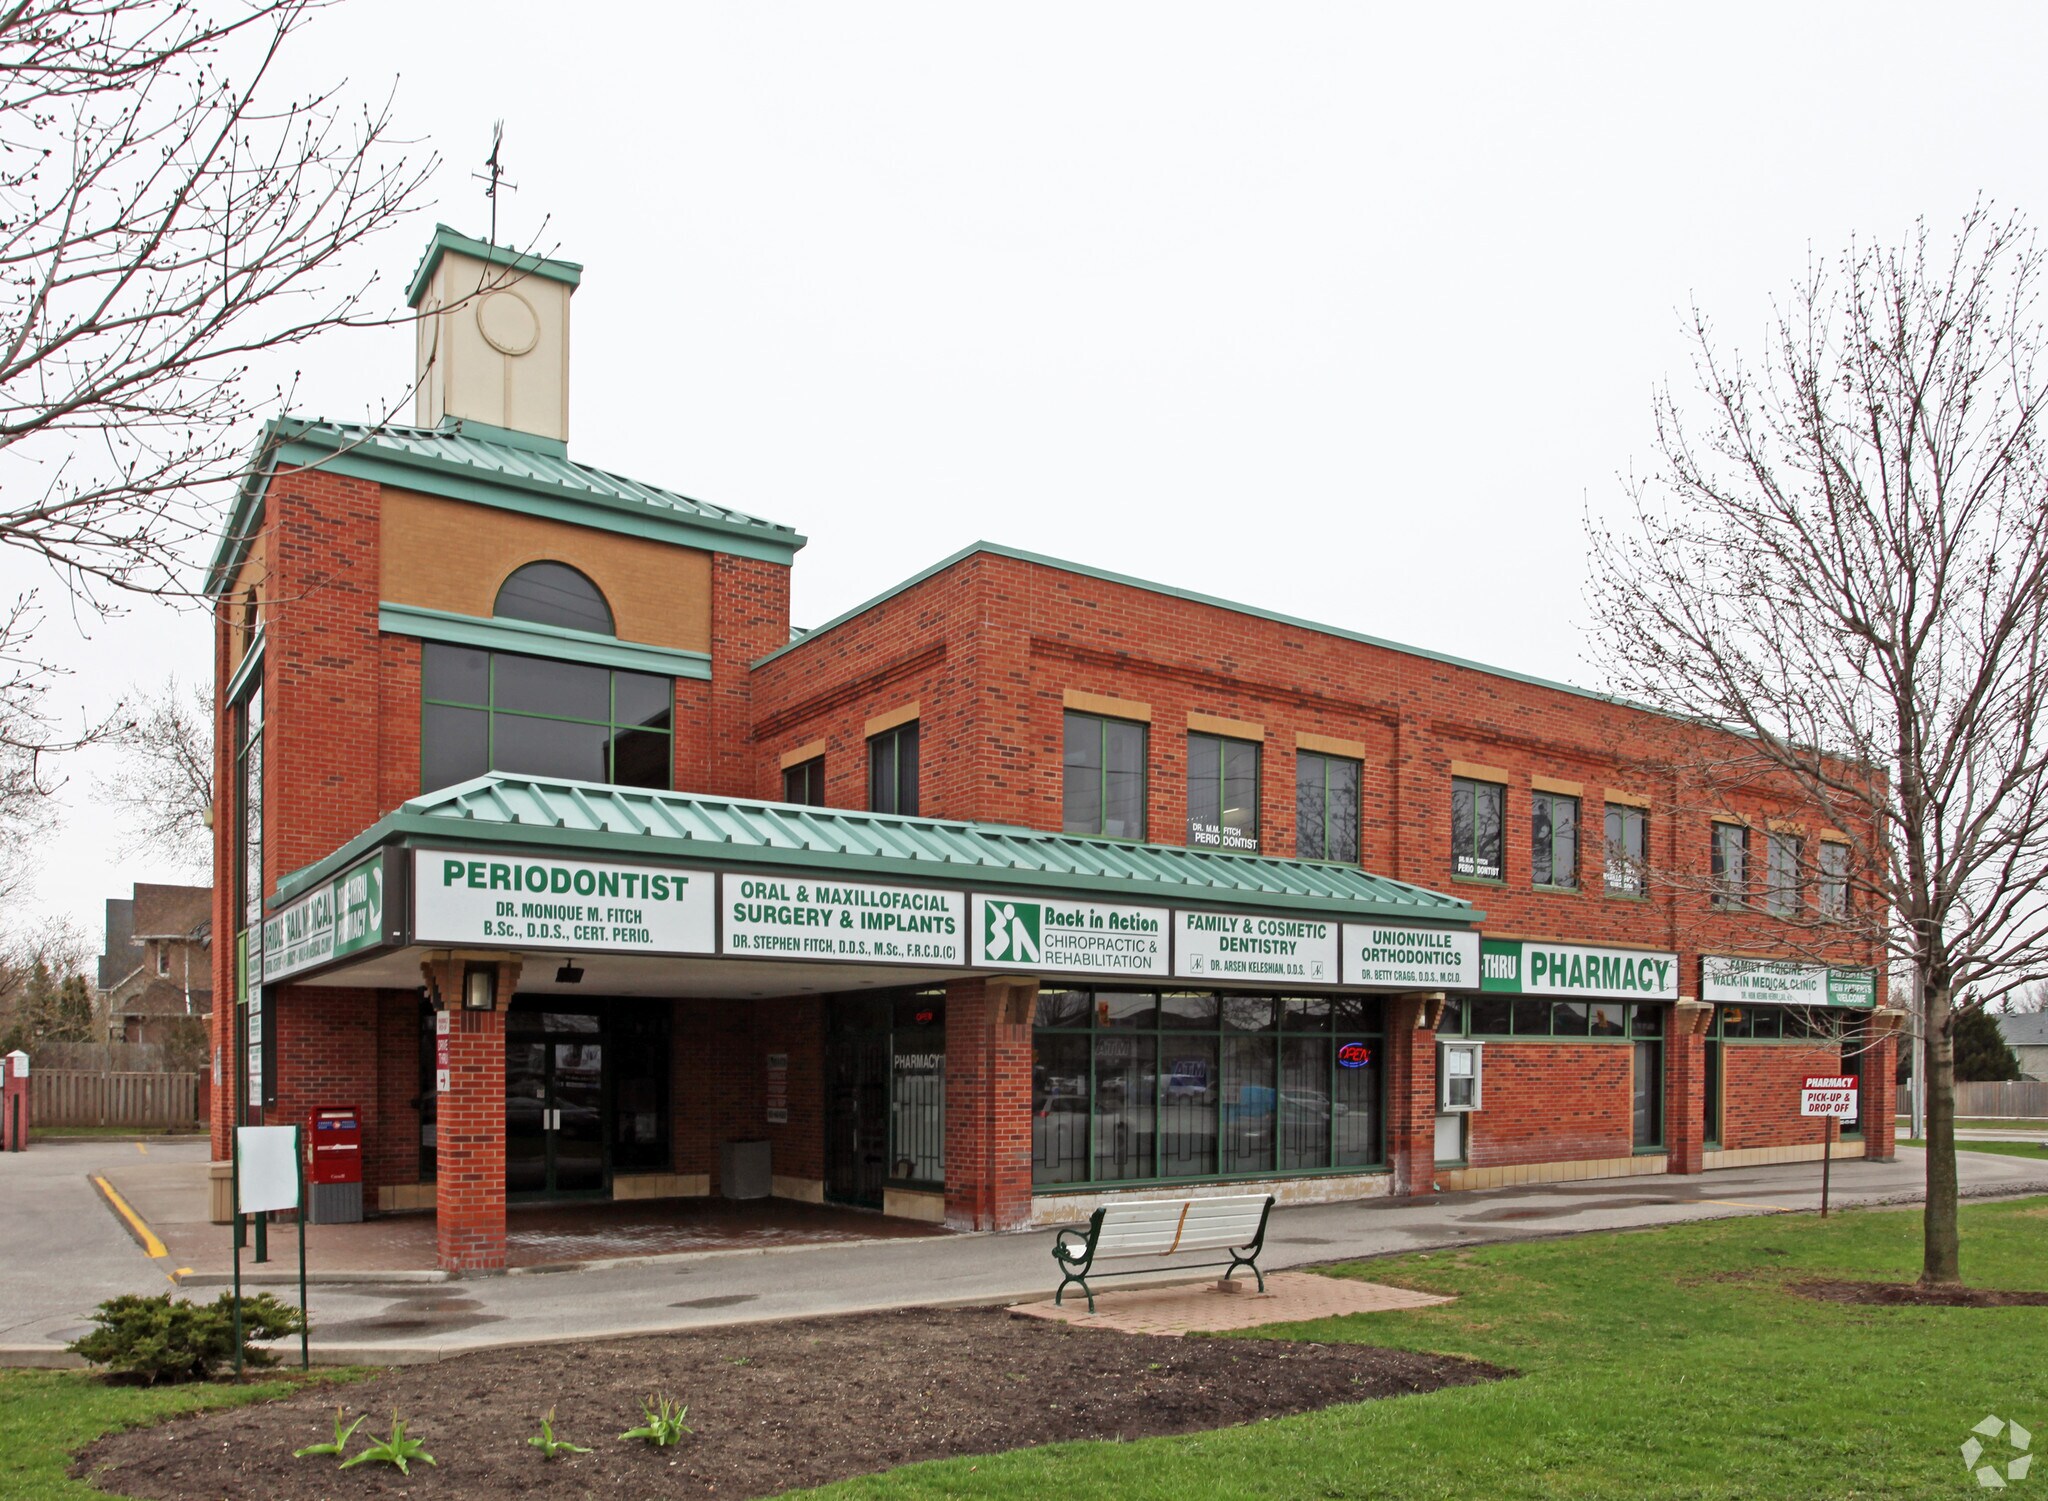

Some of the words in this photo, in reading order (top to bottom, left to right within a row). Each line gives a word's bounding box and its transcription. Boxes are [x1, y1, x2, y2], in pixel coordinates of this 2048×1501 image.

[1193, 823, 1203, 831] DR.
[1223, 827, 1241, 836] FITCH
[444, 860, 688, 901] PERIODONTIST
[741, 880, 790, 901] ORAL
[797, 886, 809, 902] &
[816, 886, 949, 912] MAXILLOFACIAL
[303, 893, 332, 936] MDICAL
[496, 902, 518, 917] DR.
[522, 903, 582, 922] MONIQUE
[588, 907, 602, 922] M.
[608, 908, 642, 924] FITCH
[734, 903, 833, 927] SURGERY
[840, 910, 854, 929] &
[861, 912, 956, 934] IMPLANTS
[1045, 907, 1085, 928] Back
[1091, 909, 1103, 929] in
[1109, 912, 1158, 932] Action
[527, 923, 570, 941] D.D.S.,
[574, 926, 608, 942] CERT.
[613, 927, 653, 944] PERIO.
[1187, 915, 1236, 933] FAMILY
[1244, 918, 1253, 934] &
[1258, 920, 1326, 939] COSMETIC
[733, 934, 750, 948] DR.
[754, 935, 800, 951] STEPHEN
[804, 938, 836, 954] FITCH,
[840, 940, 871, 956] D.D.S.,
[907, 944, 956, 960] F.R.C.D.(C)
[1045, 934, 1145, 952] CHIROPRACTIC
[1150, 944, 1157, 953] &
[1220, 937, 1296, 955] DENTISTRY
[1373, 931, 1452, 948] UNIONVILLE
[1046, 951, 1152, 968] REHABILITATION
[1362, 948, 1461, 965] ORTHODONTICS
[1211, 960, 1222, 971] DR.
[1224, 961, 1246, 972] ARSEN
[1287, 964, 1305, 975] D.D.S.
[1362, 969, 1372, 980] DR.
[1375, 970, 1392, 980] BETTY
[1532, 952, 1670, 992] PHARMACY
[1713, 973, 1749, 987] WALK-IN
[1753, 976, 1787, 989] MEDICAL
[1790, 979, 1816, 991] CLINIC
[1830, 984, 1844, 992] NEW
[1837, 993, 1866, 1003] WELCOME
[1096, 1039, 1130, 1056] ATM
[1338, 1048, 1370, 1061] OPEN
[894, 1054, 940, 1068] PHARMACY
[1174, 1061, 1206, 1077] ATM
[1806, 1078, 1854, 1088] PHARMACY
[1808, 1093, 1842, 1101] PICK-UP
[1844, 1093, 1850, 1102] &
[1809, 1104, 1832, 1112] DROP
[1834, 1104, 1849, 1112] OFF
